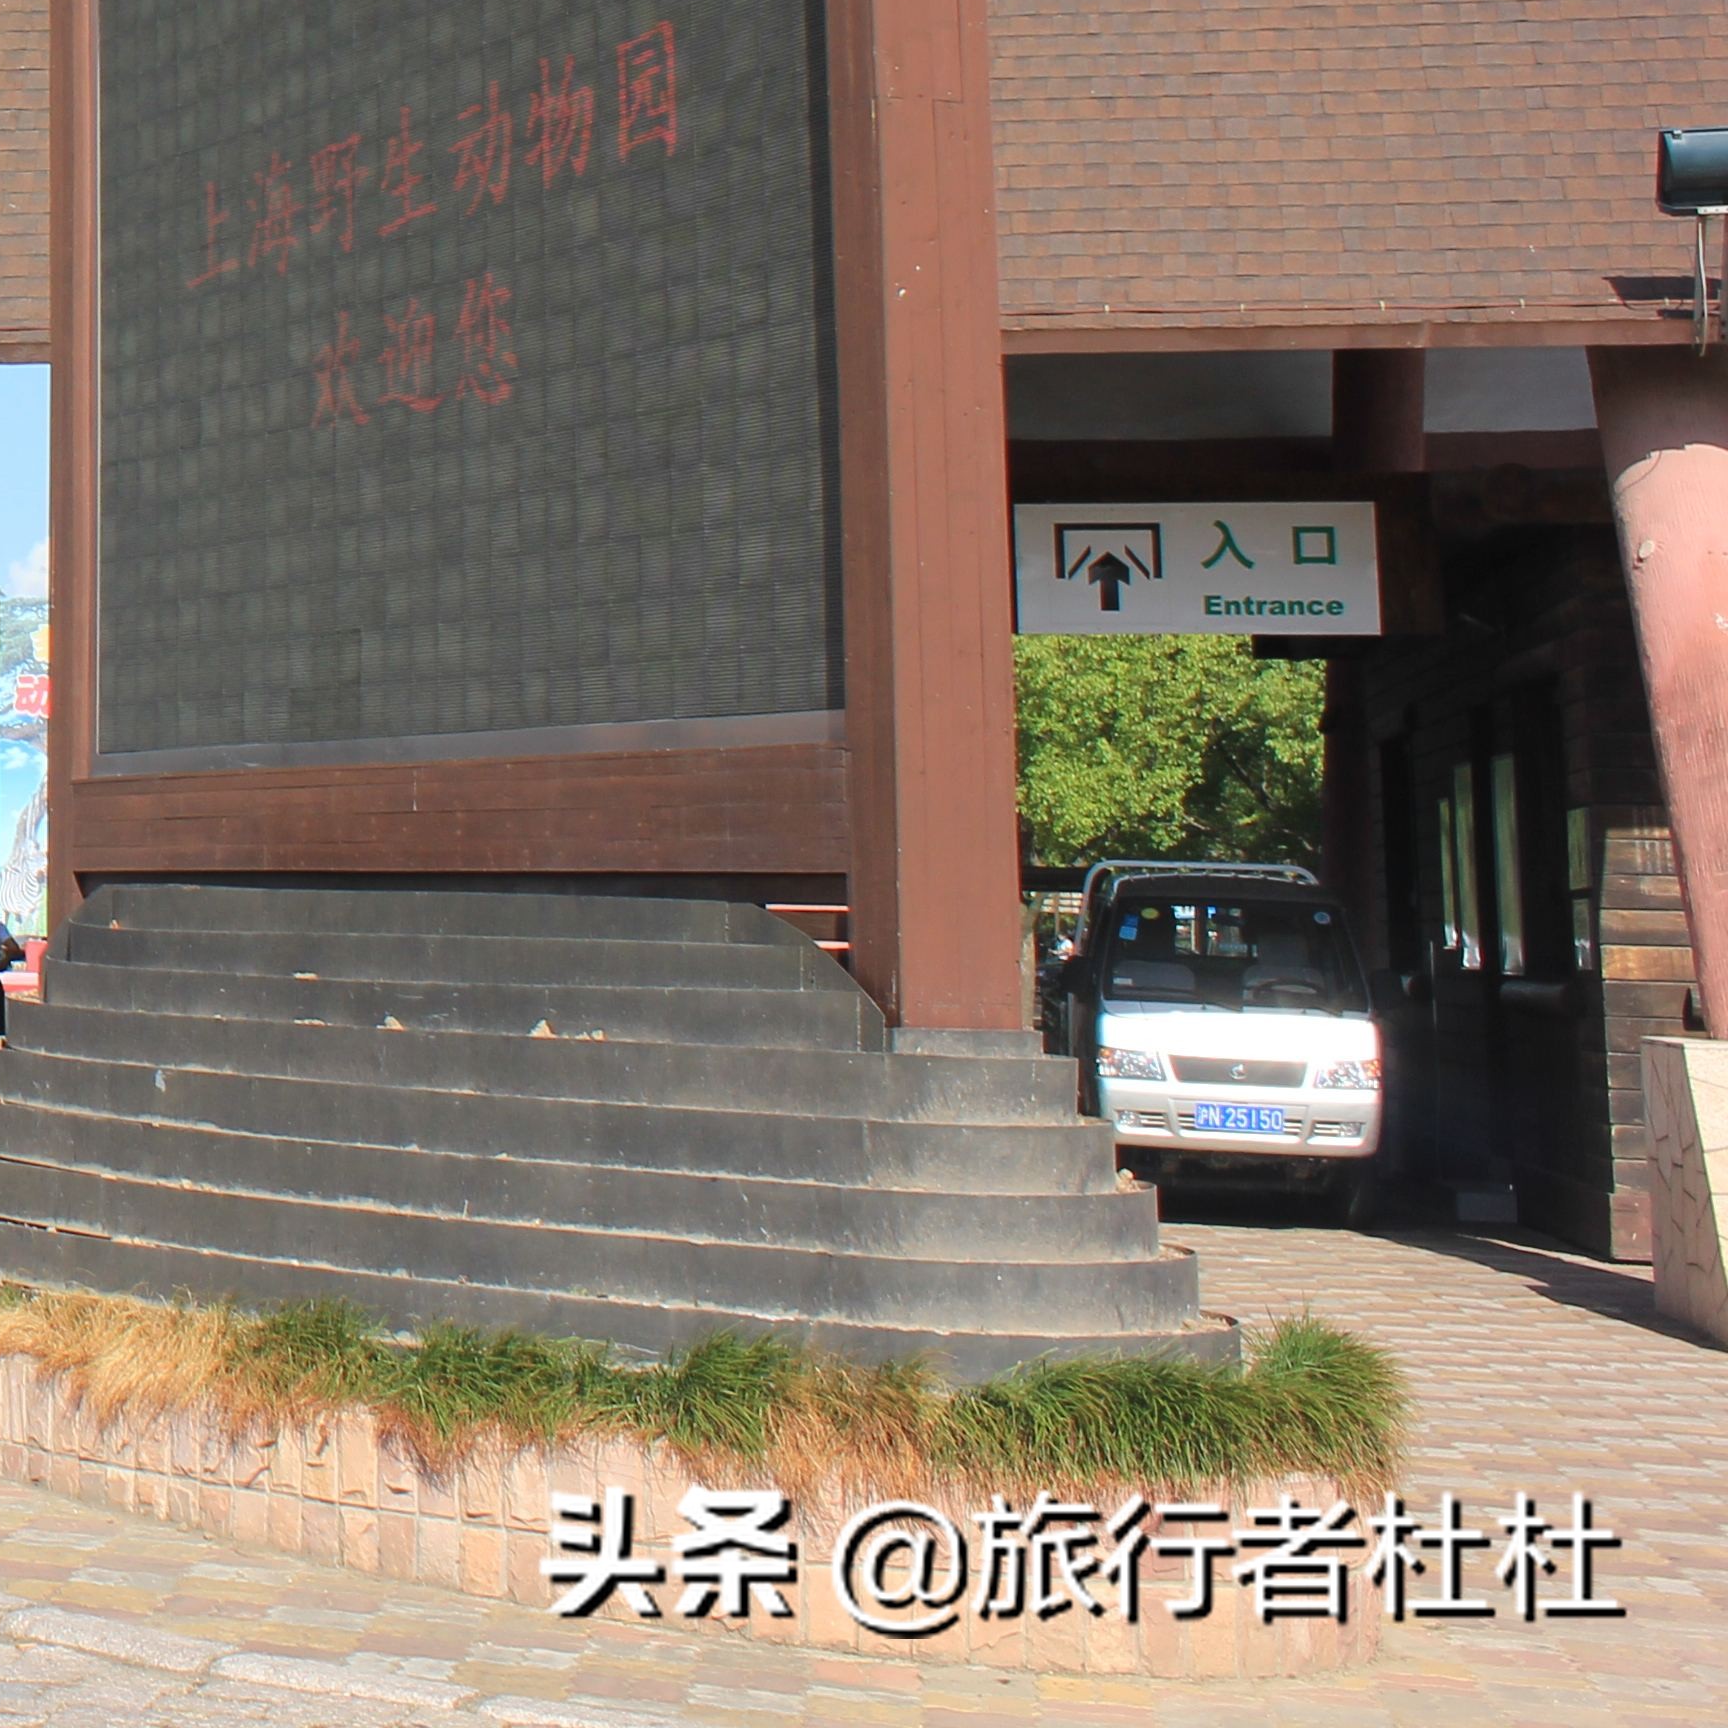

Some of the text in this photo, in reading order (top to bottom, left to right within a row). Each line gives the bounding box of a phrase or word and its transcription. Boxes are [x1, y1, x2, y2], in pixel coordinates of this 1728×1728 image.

[185, 20, 677, 290] 上海野生动物园
[311, 273, 518, 428] 欢迎您
[1201, 520, 1337, 569] 入口
[1203, 594, 1344, 617] Entrance
